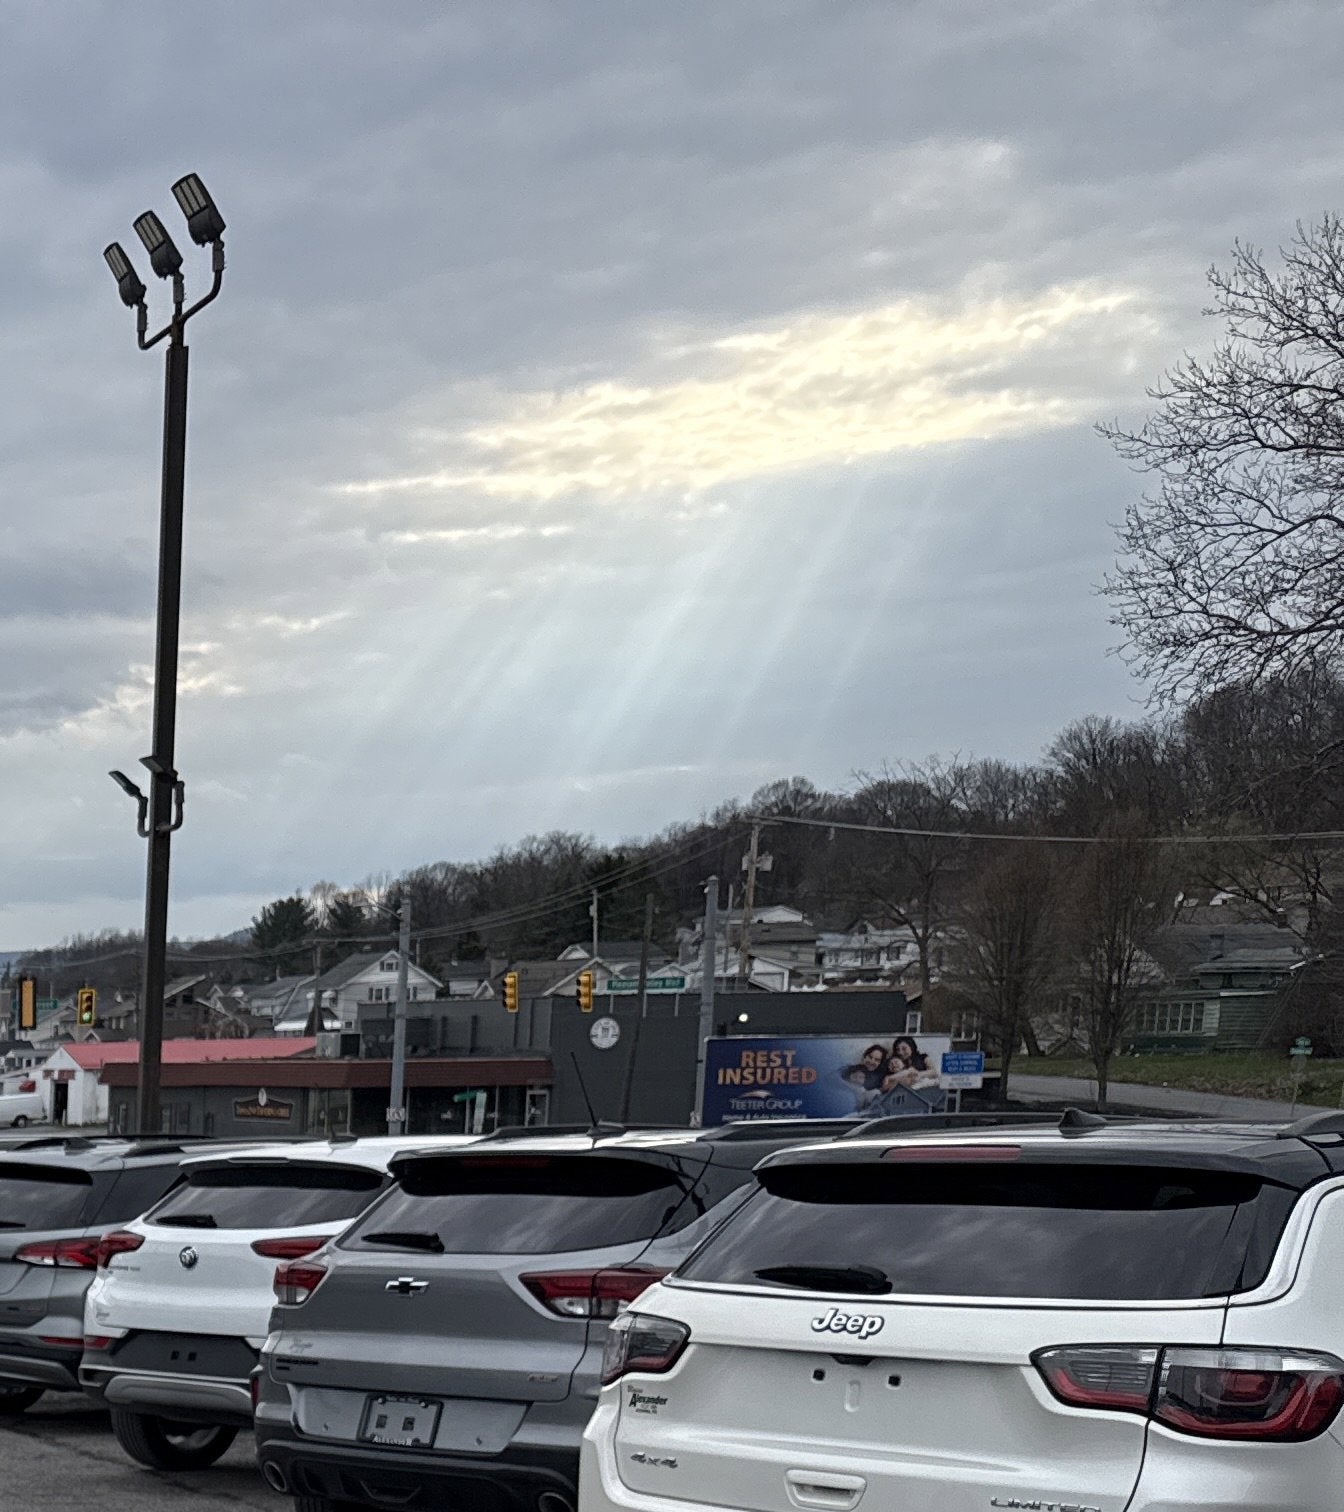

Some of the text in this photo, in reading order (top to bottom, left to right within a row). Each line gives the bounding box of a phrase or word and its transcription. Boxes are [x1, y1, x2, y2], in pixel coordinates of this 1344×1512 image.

[740, 1050, 796, 1067] REST
[717, 1067, 817, 1085] INSURED
[729, 1098, 802, 1110] TEETER GROUP
[812, 1308, 885, 1340] Jeep
